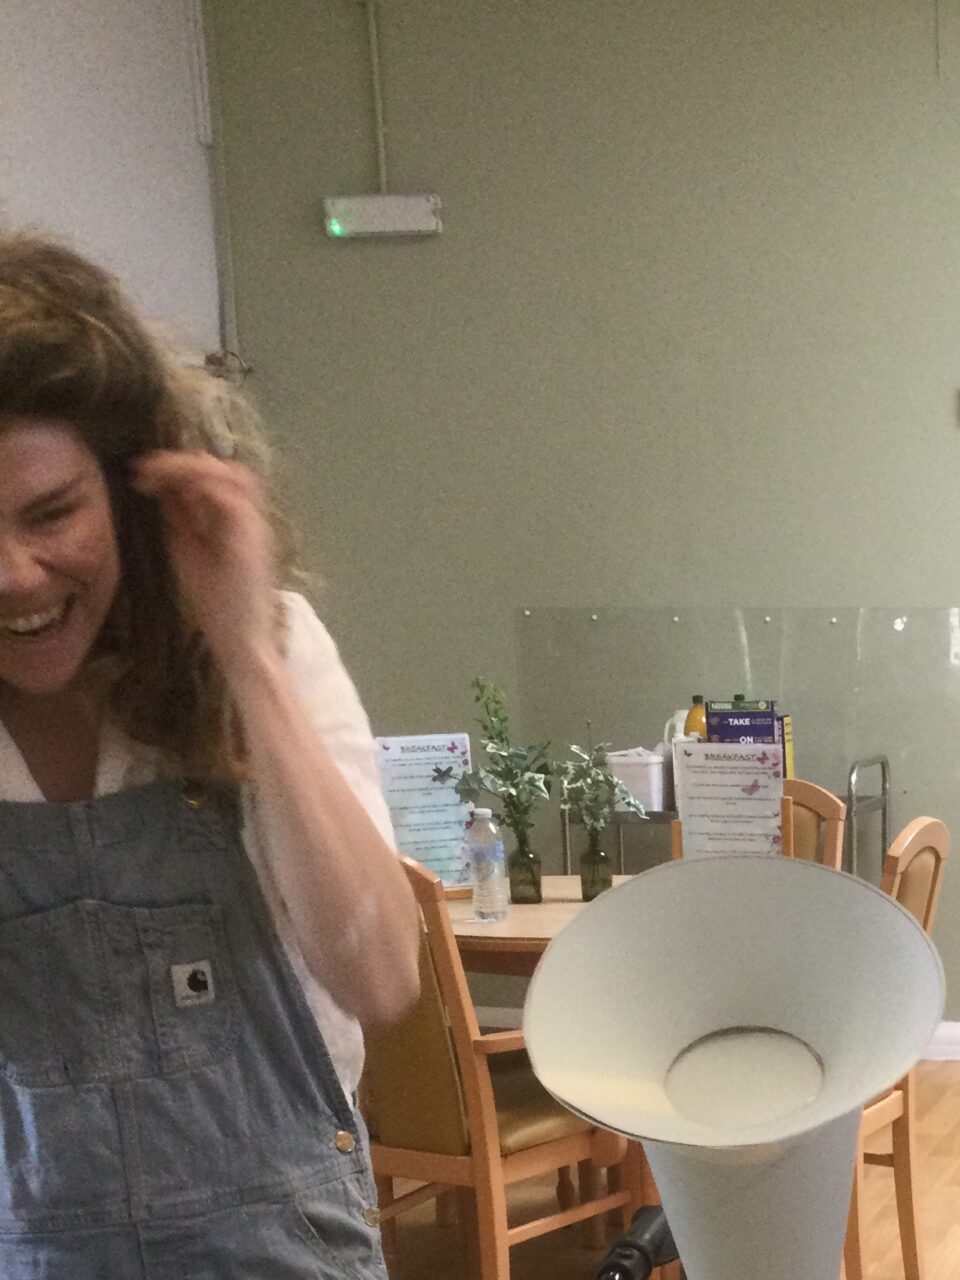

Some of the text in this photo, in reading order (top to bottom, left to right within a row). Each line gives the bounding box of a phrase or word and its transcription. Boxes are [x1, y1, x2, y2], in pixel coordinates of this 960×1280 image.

[728, 718, 751, 726] TAKE
[739, 736, 754, 744] ON
[400, 744, 447, 754] BREAKFAST
[704, 752, 757, 762] BREAKFAST
